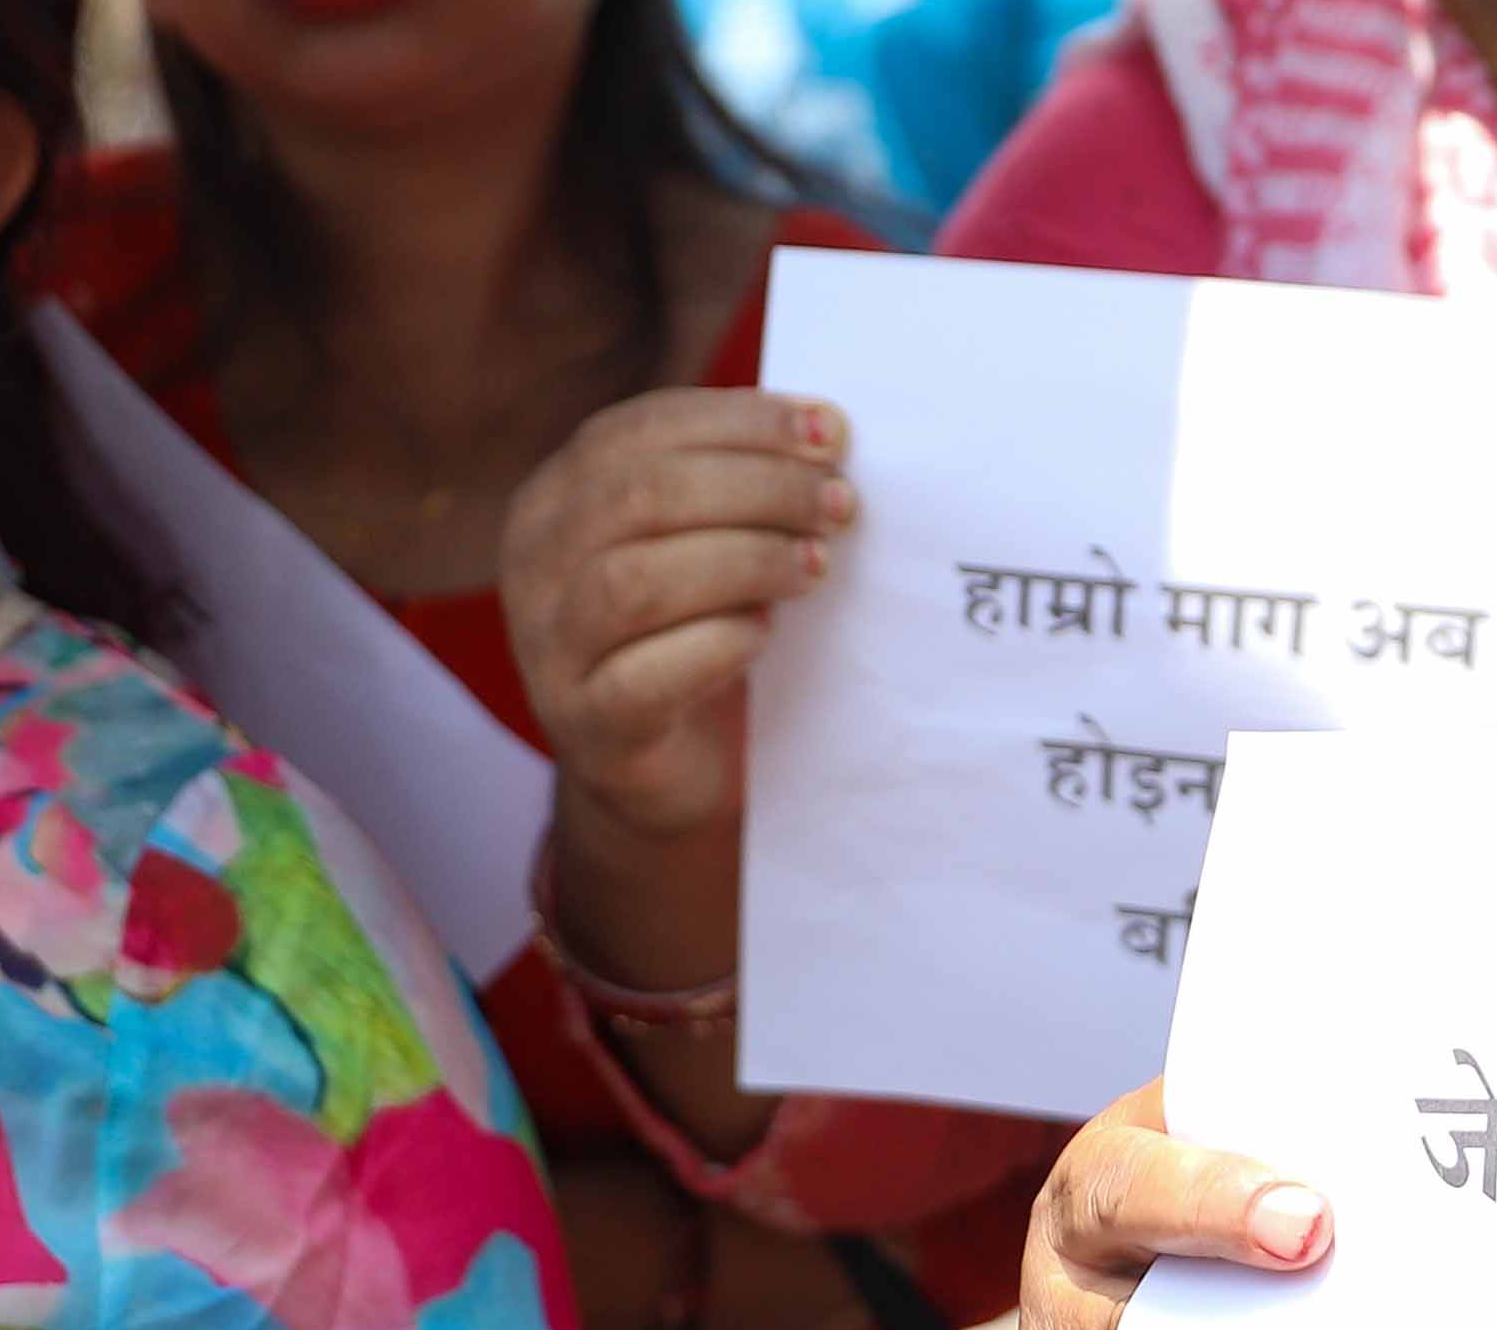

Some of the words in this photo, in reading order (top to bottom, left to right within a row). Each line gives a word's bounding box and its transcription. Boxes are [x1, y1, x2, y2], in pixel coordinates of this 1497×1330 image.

[956, 544, 1137, 639] हाम्रो
[1159, 579, 1319, 659] माग
[1343, 597, 1491, 673] अब
